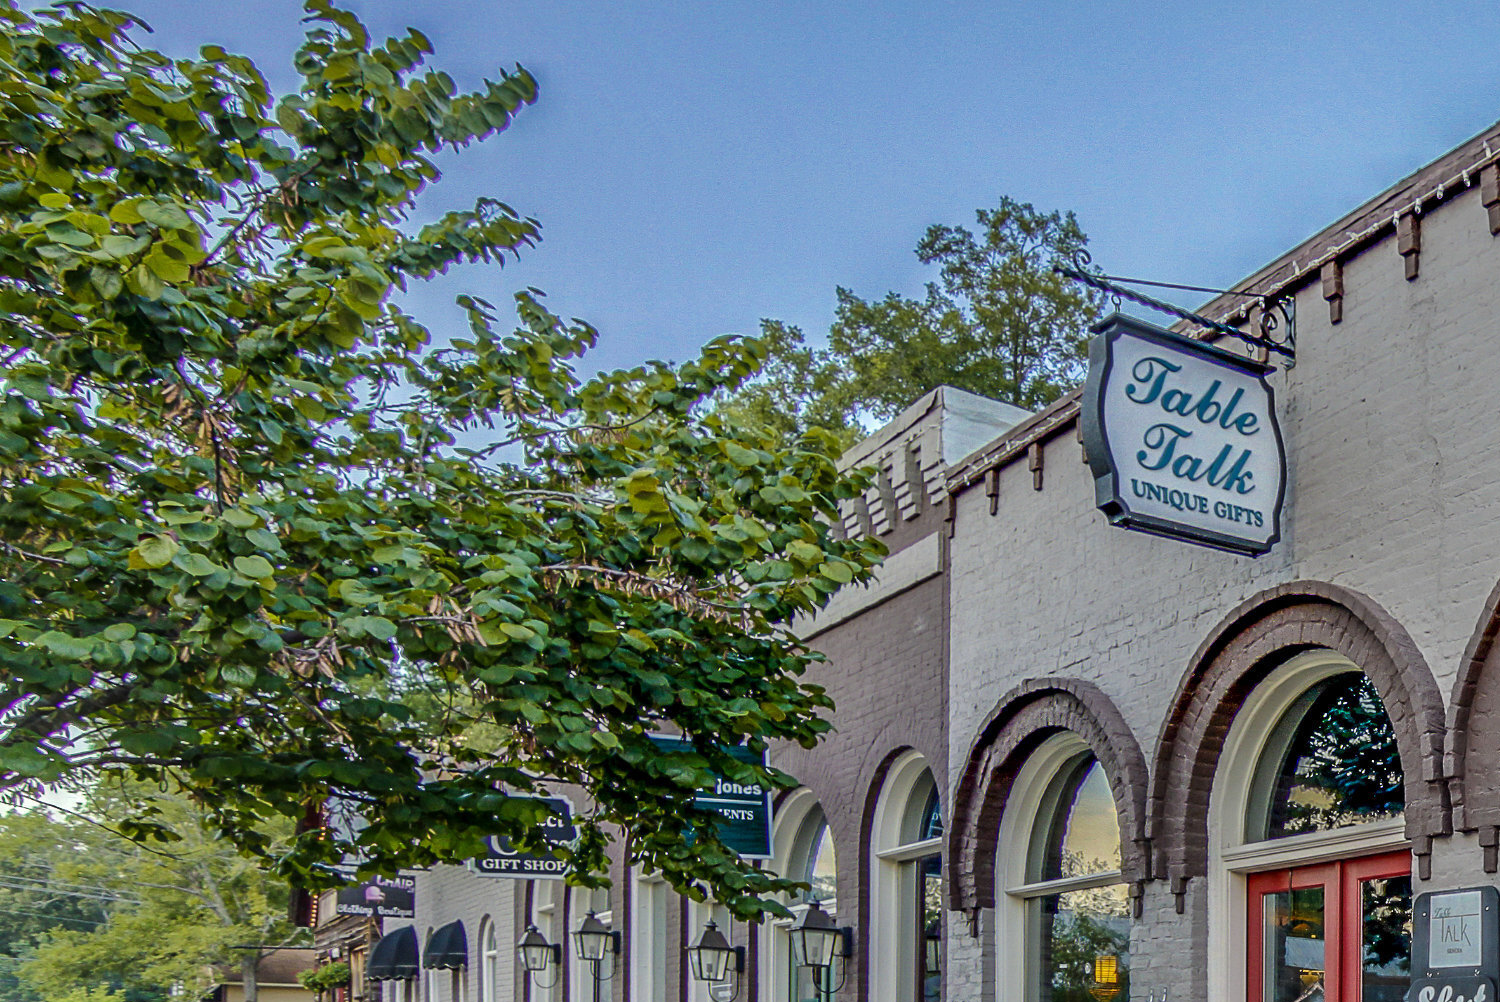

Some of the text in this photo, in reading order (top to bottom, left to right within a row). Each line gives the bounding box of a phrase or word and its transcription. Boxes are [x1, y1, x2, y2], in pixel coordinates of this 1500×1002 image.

[1125, 356, 1260, 435] Table
[1136, 423, 1256, 494] Talk
[1131, 478, 1264, 527] UNIQUE GIFTS
[482, 858, 566, 871] GIFT SHOP
[1439, 914, 1472, 946] TALK
